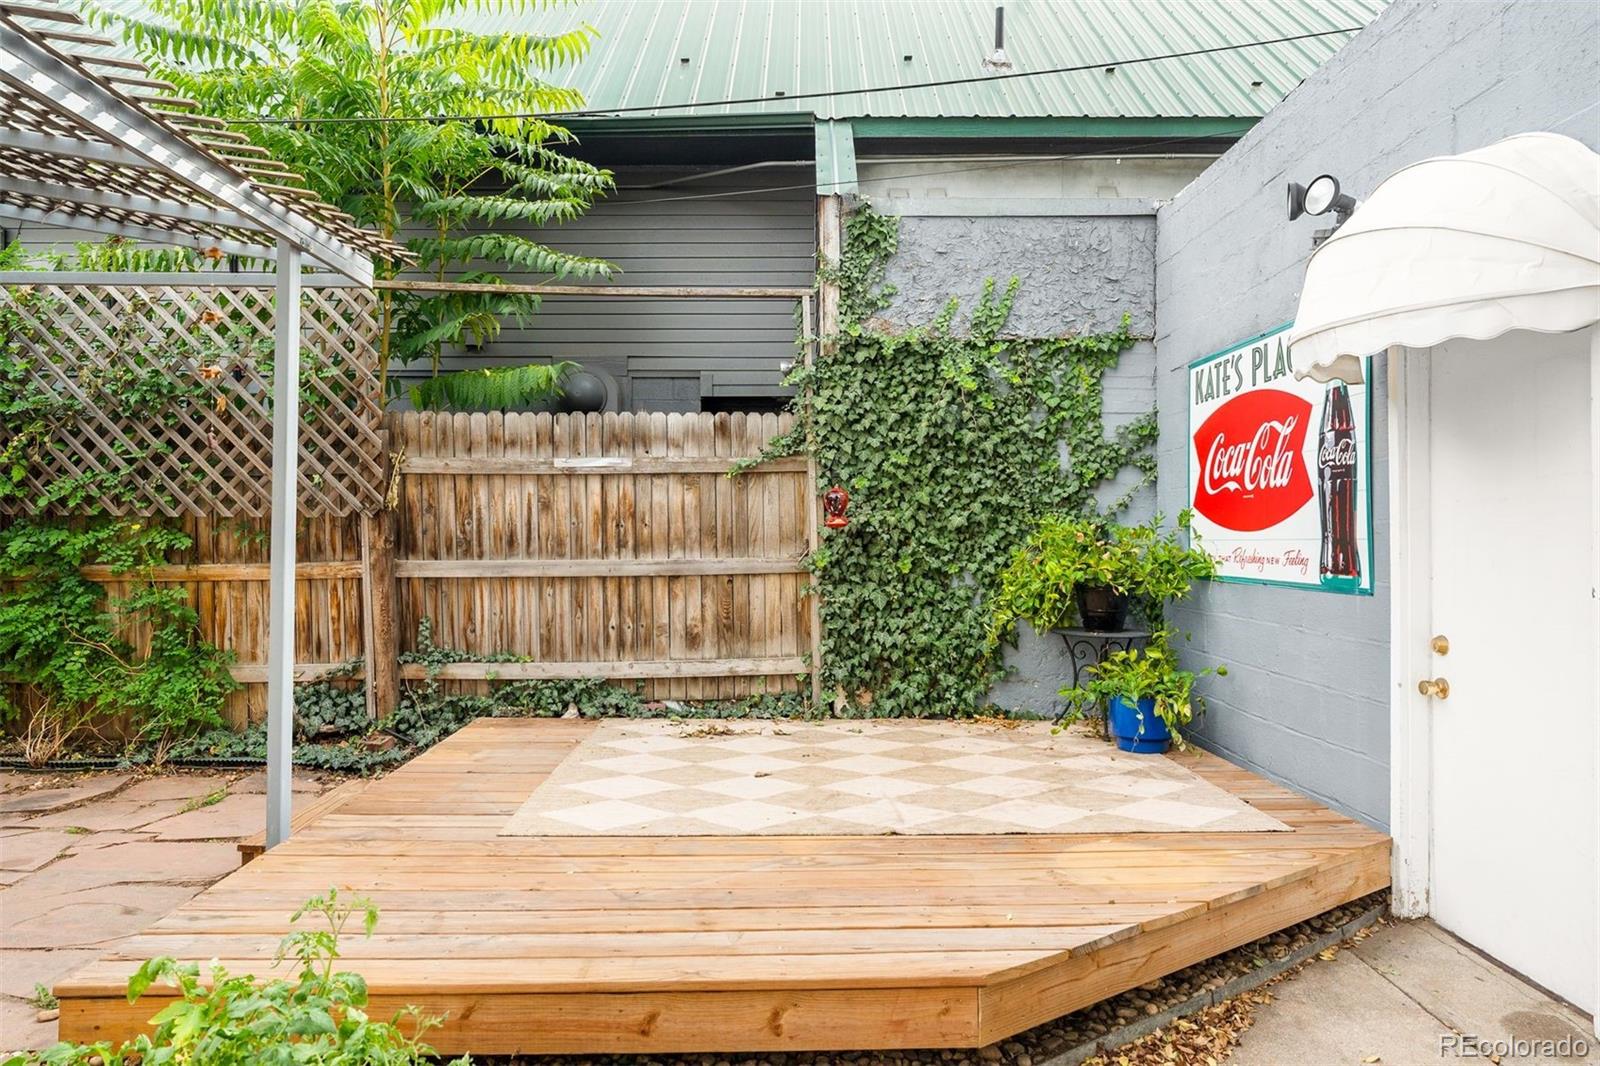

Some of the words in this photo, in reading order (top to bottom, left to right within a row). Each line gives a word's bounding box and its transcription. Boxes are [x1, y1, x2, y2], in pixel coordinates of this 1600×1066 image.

[1195, 353, 1243, 405] KATE'S
[1204, 414, 1299, 495] Coca-Cola
[1319, 438, 1356, 468] Coca-Cola
[1283, 549, 1309, 575] Feeling
